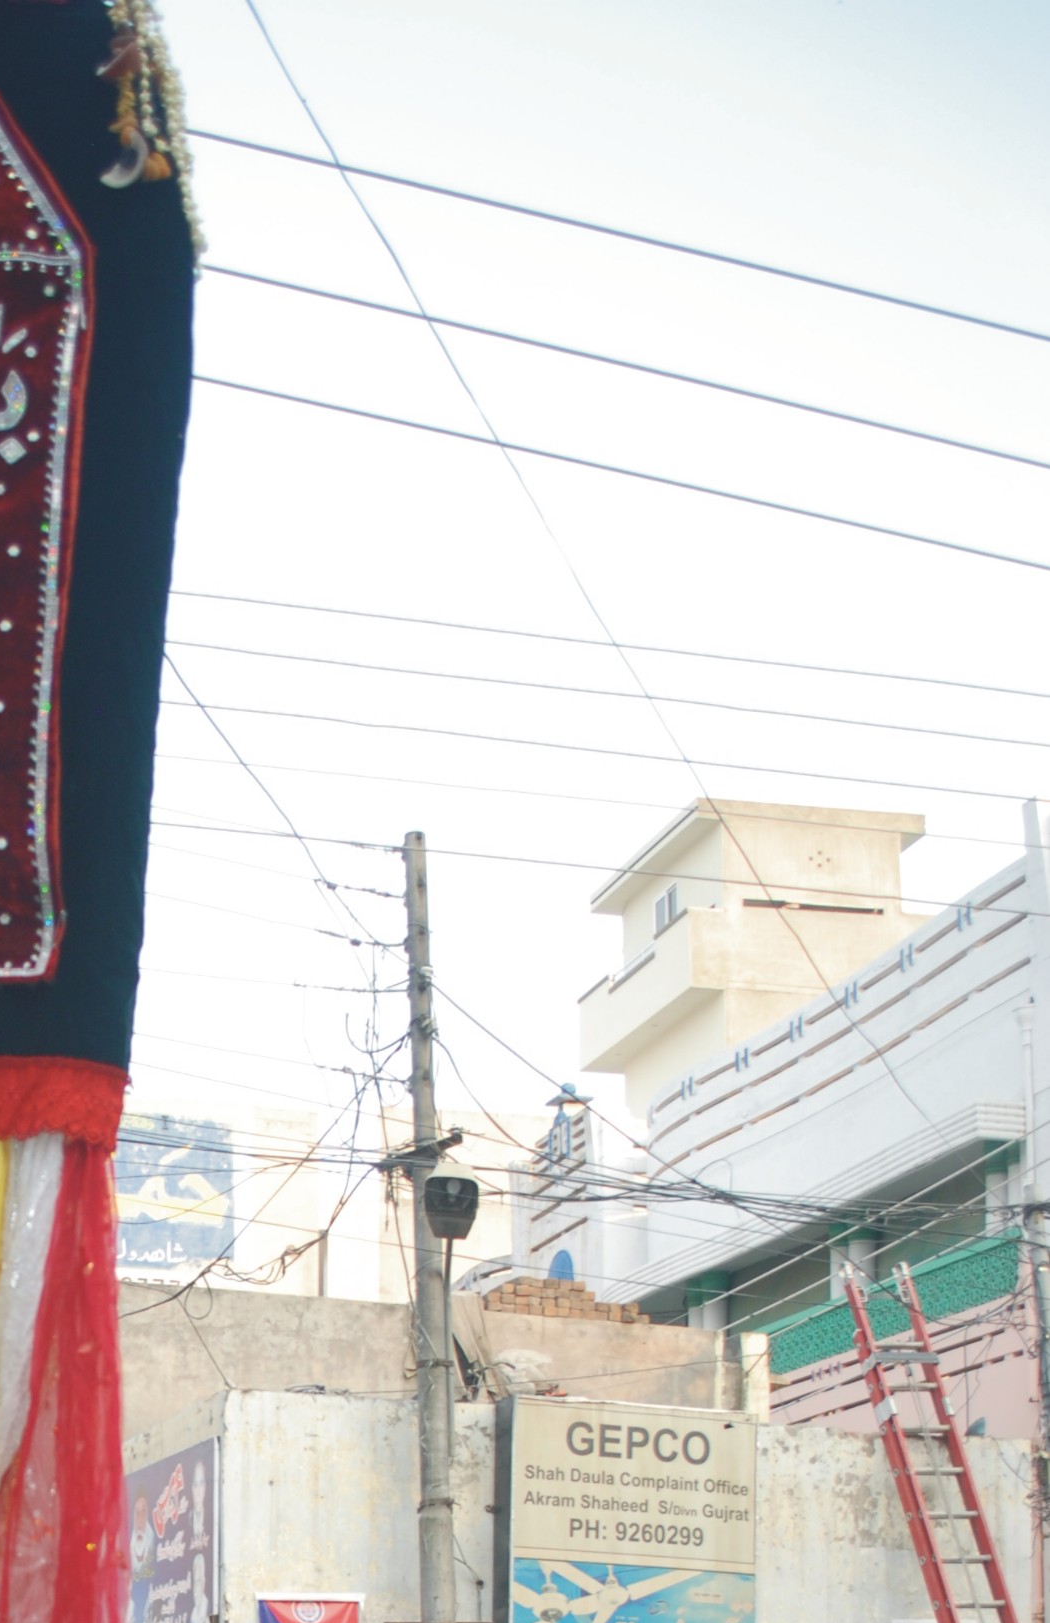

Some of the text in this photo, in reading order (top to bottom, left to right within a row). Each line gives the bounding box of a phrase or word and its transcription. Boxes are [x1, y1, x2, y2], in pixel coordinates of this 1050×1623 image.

[566, 1421, 710, 1465] GEPCO
[524, 1465, 749, 1497] Shah Daula Complaint Office
[524, 1491, 575, 1508] Akram
[580, 1494, 648, 1513] Shaheed
[702, 1504, 750, 1522] Gujrat
[569, 1518, 705, 1547] PH: 9260299
